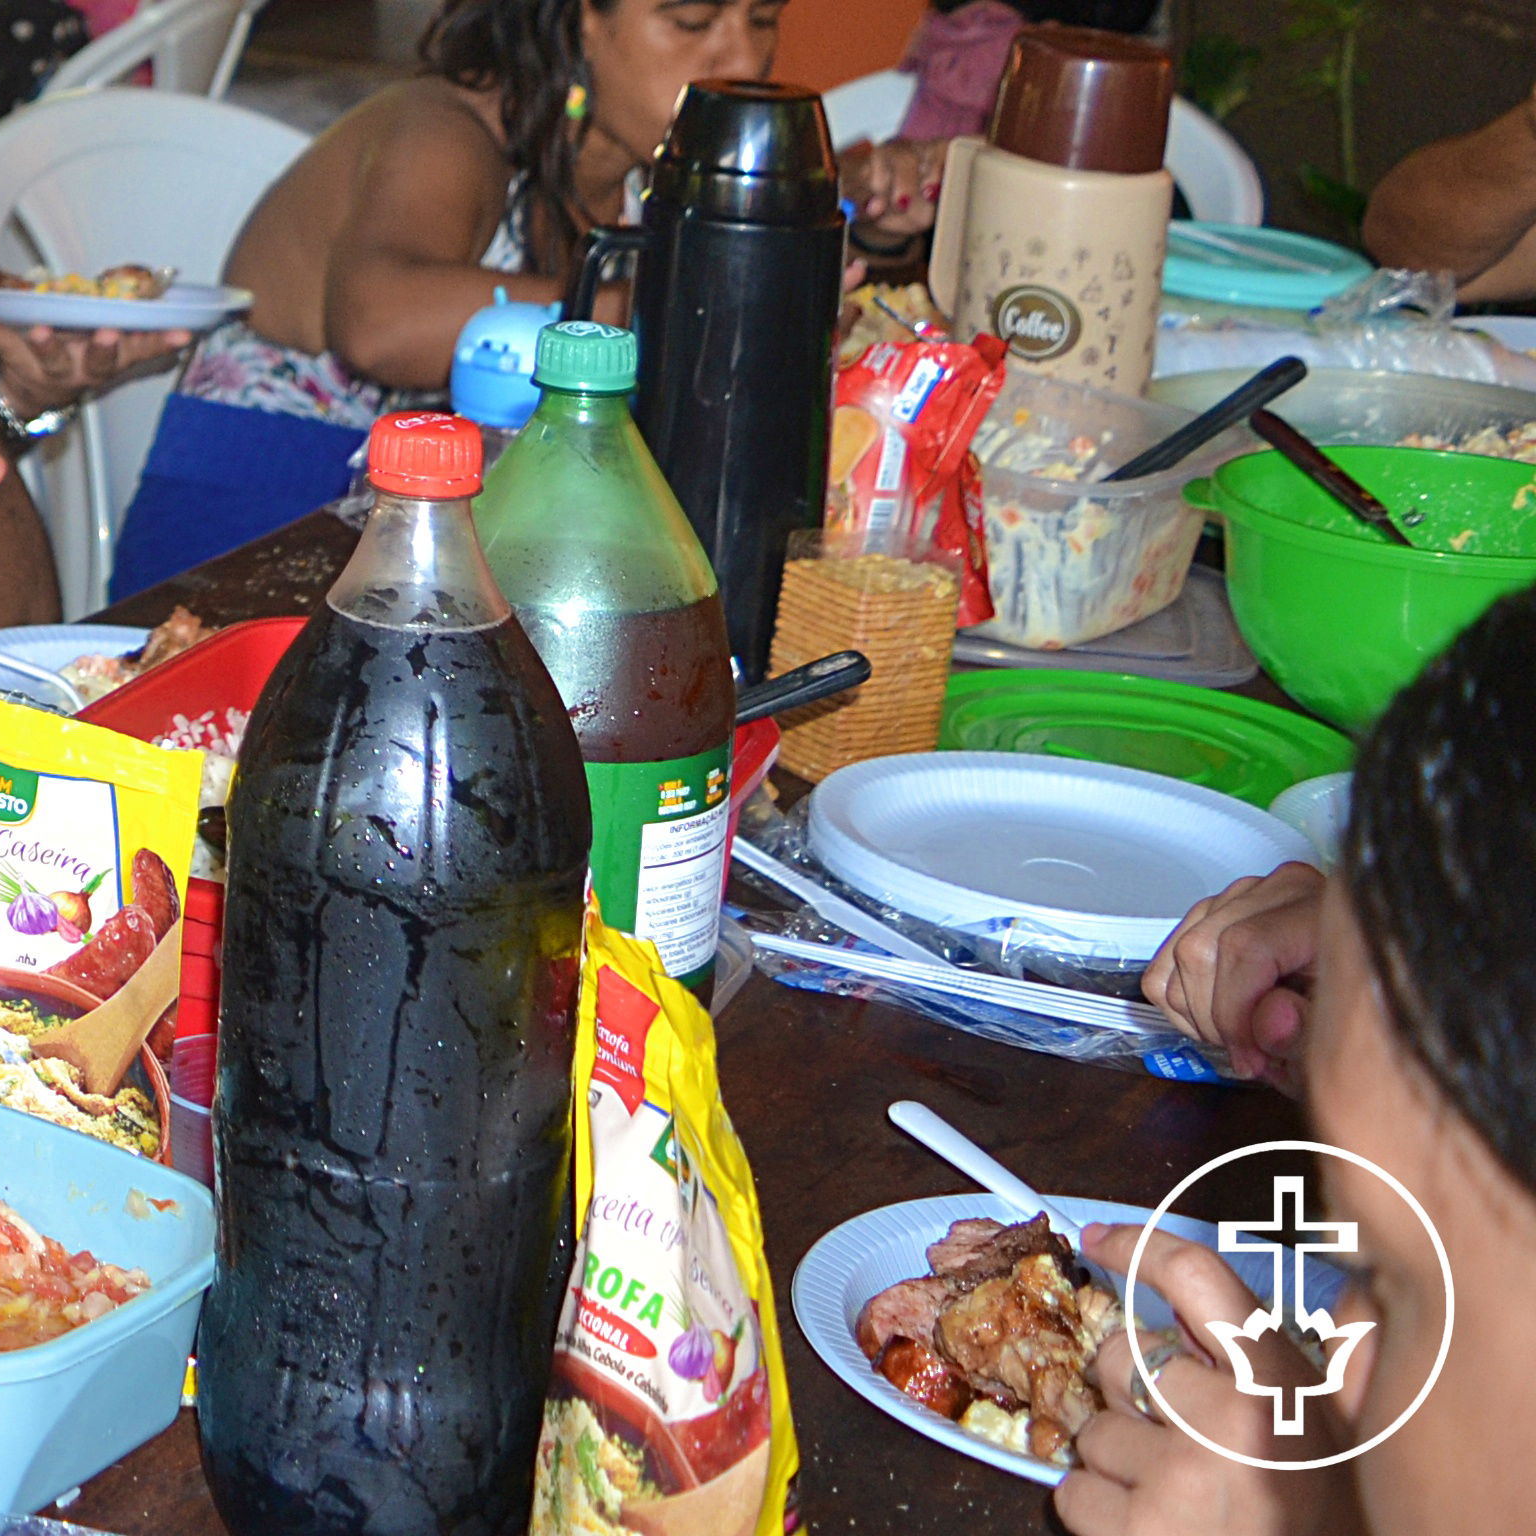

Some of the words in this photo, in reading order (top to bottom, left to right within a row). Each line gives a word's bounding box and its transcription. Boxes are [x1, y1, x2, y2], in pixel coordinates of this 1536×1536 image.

[1005, 305, 1063, 343] Coffee
[592, 1194, 654, 1237] ceita
[583, 1251, 665, 1329] ROFA
